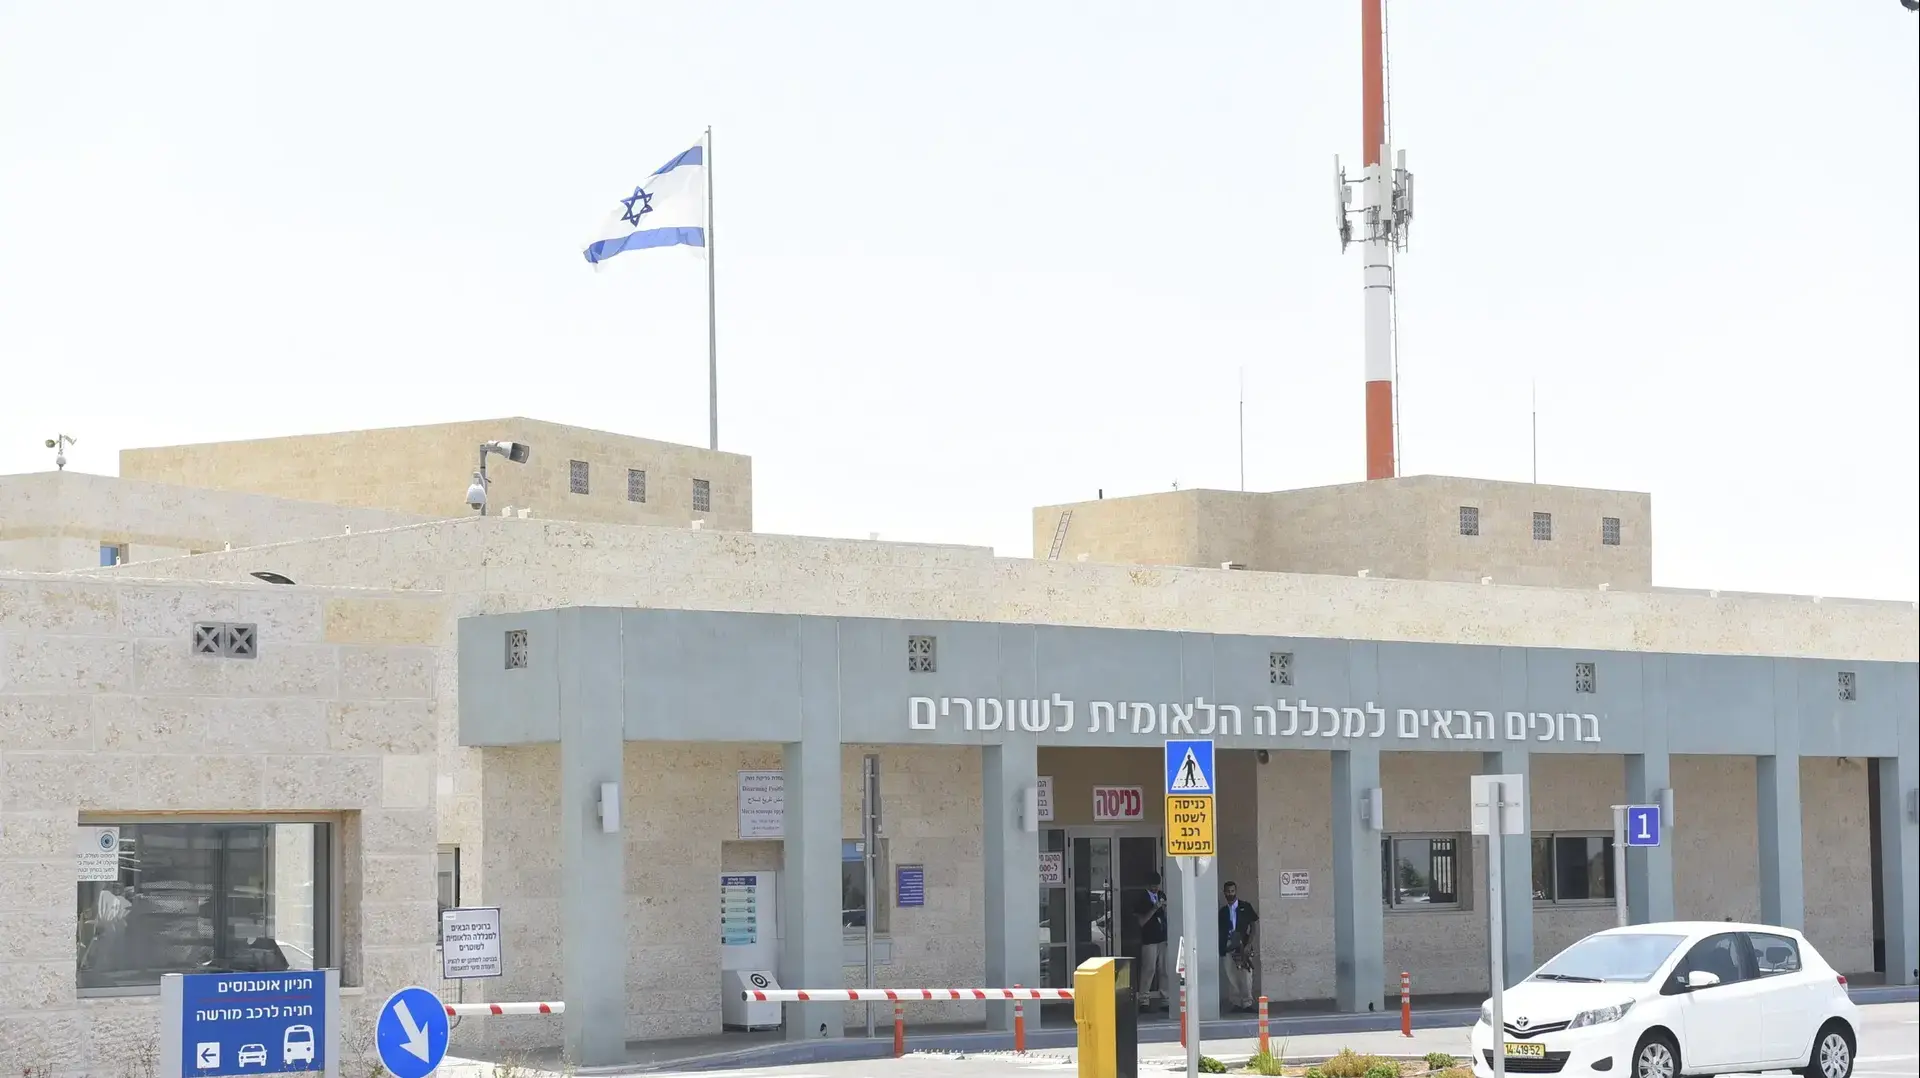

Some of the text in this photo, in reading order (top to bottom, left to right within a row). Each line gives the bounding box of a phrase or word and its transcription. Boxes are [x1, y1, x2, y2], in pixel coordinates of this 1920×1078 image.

[908, 693, 1601, 742] ברוכים הבאים למכללה הלאומית לשוטרים
[1095, 789, 1141, 817] כניסה
[1174, 800, 1206, 810] כניסה
[1174, 811, 1206, 823] לשטח
[1637, 813, 1651, 839] 1
[1180, 827, 1201, 837] רכב
[1171, 840, 1211, 851] תפעולי
[450, 923, 491, 932] ברוכים הבאים
[445, 932, 497, 942] למכללה הלאומית
[458, 943, 485, 952] לשוטרים
[218, 978, 313, 993] חניון אוטבוסים
[196, 1005, 313, 1022] חניה לרכב מורשה
